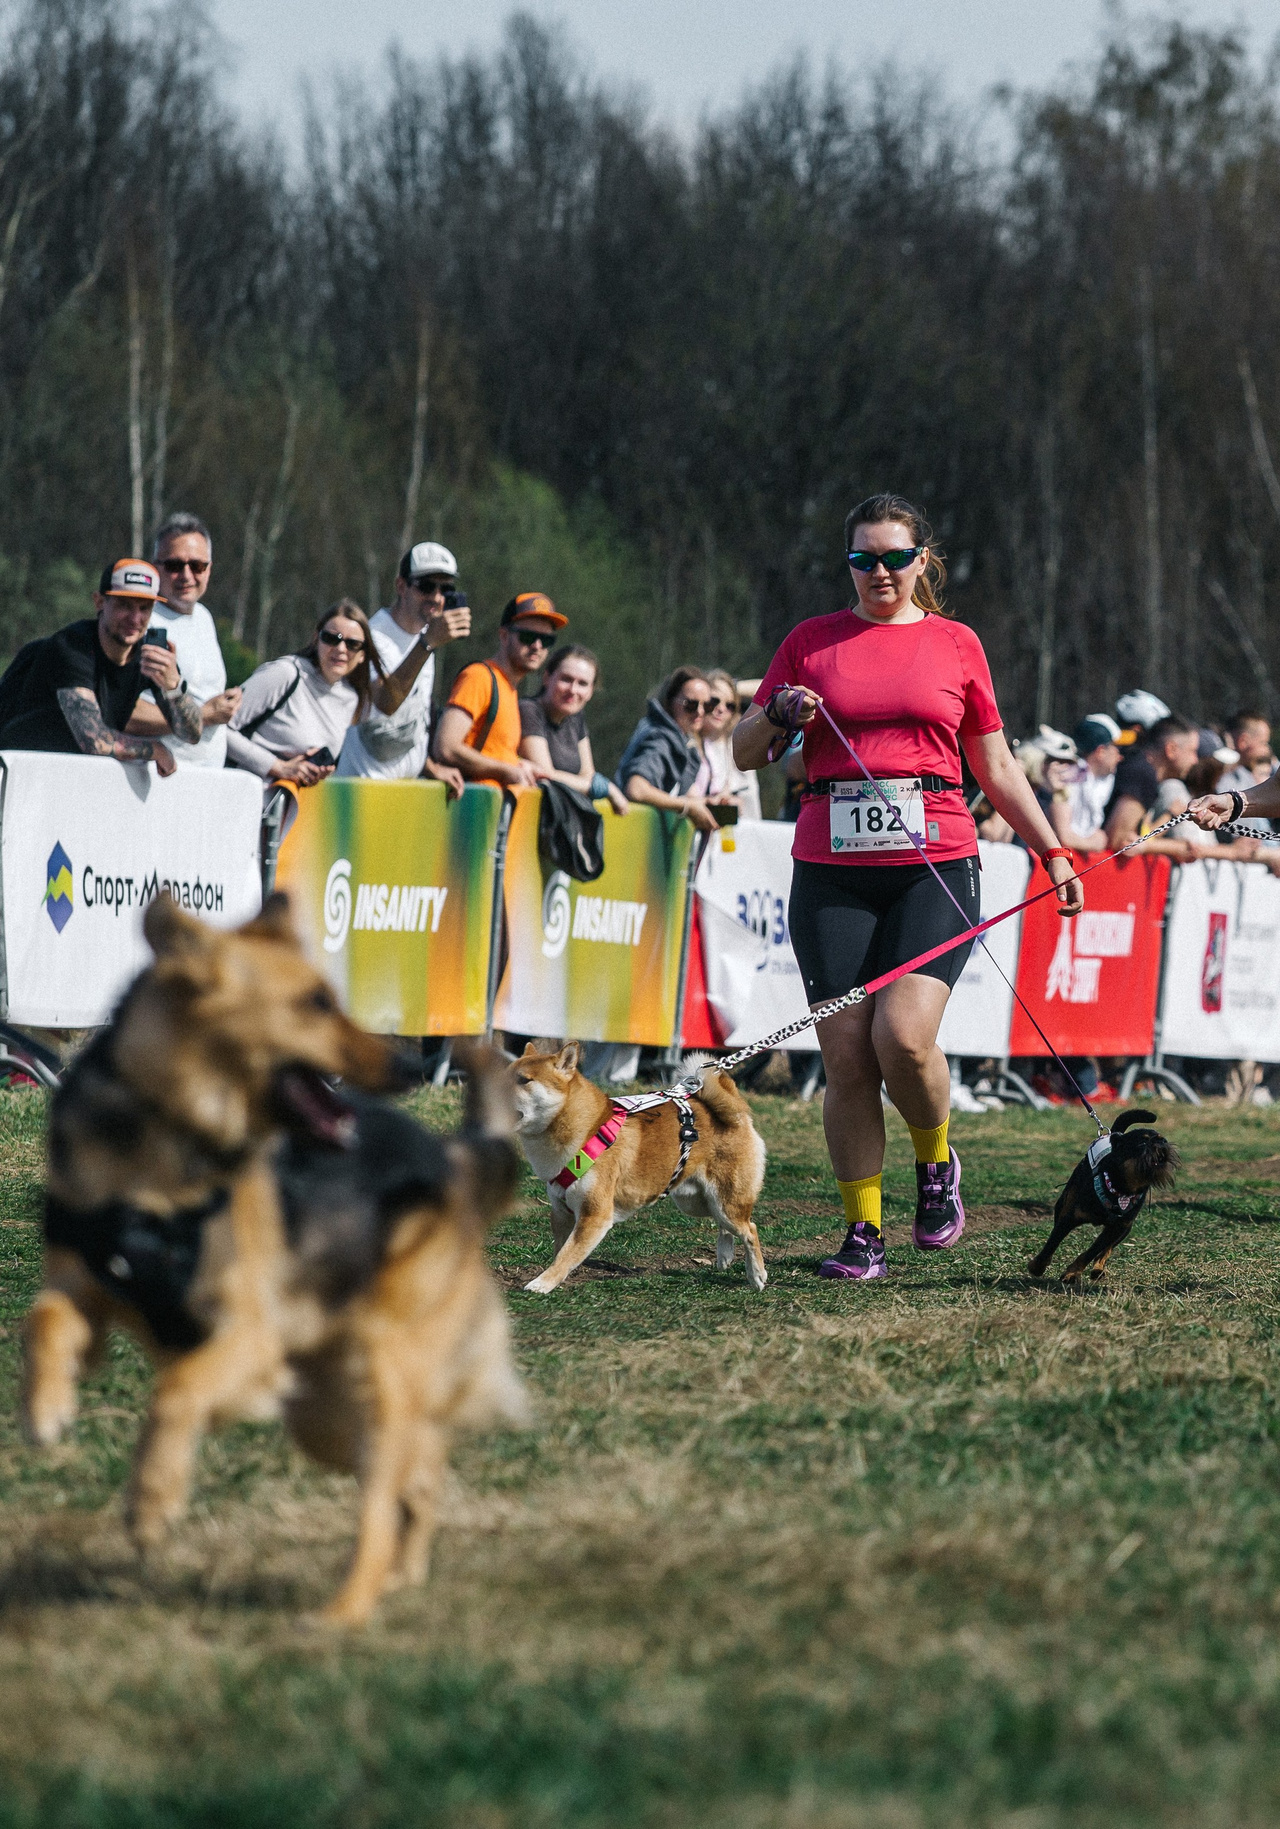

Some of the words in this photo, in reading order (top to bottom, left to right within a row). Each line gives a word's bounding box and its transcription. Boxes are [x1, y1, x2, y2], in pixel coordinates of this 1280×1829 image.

[850, 805, 903, 833] 182
[353, 883, 448, 933] INSANITY
[572, 895, 648, 946] INSANITY
